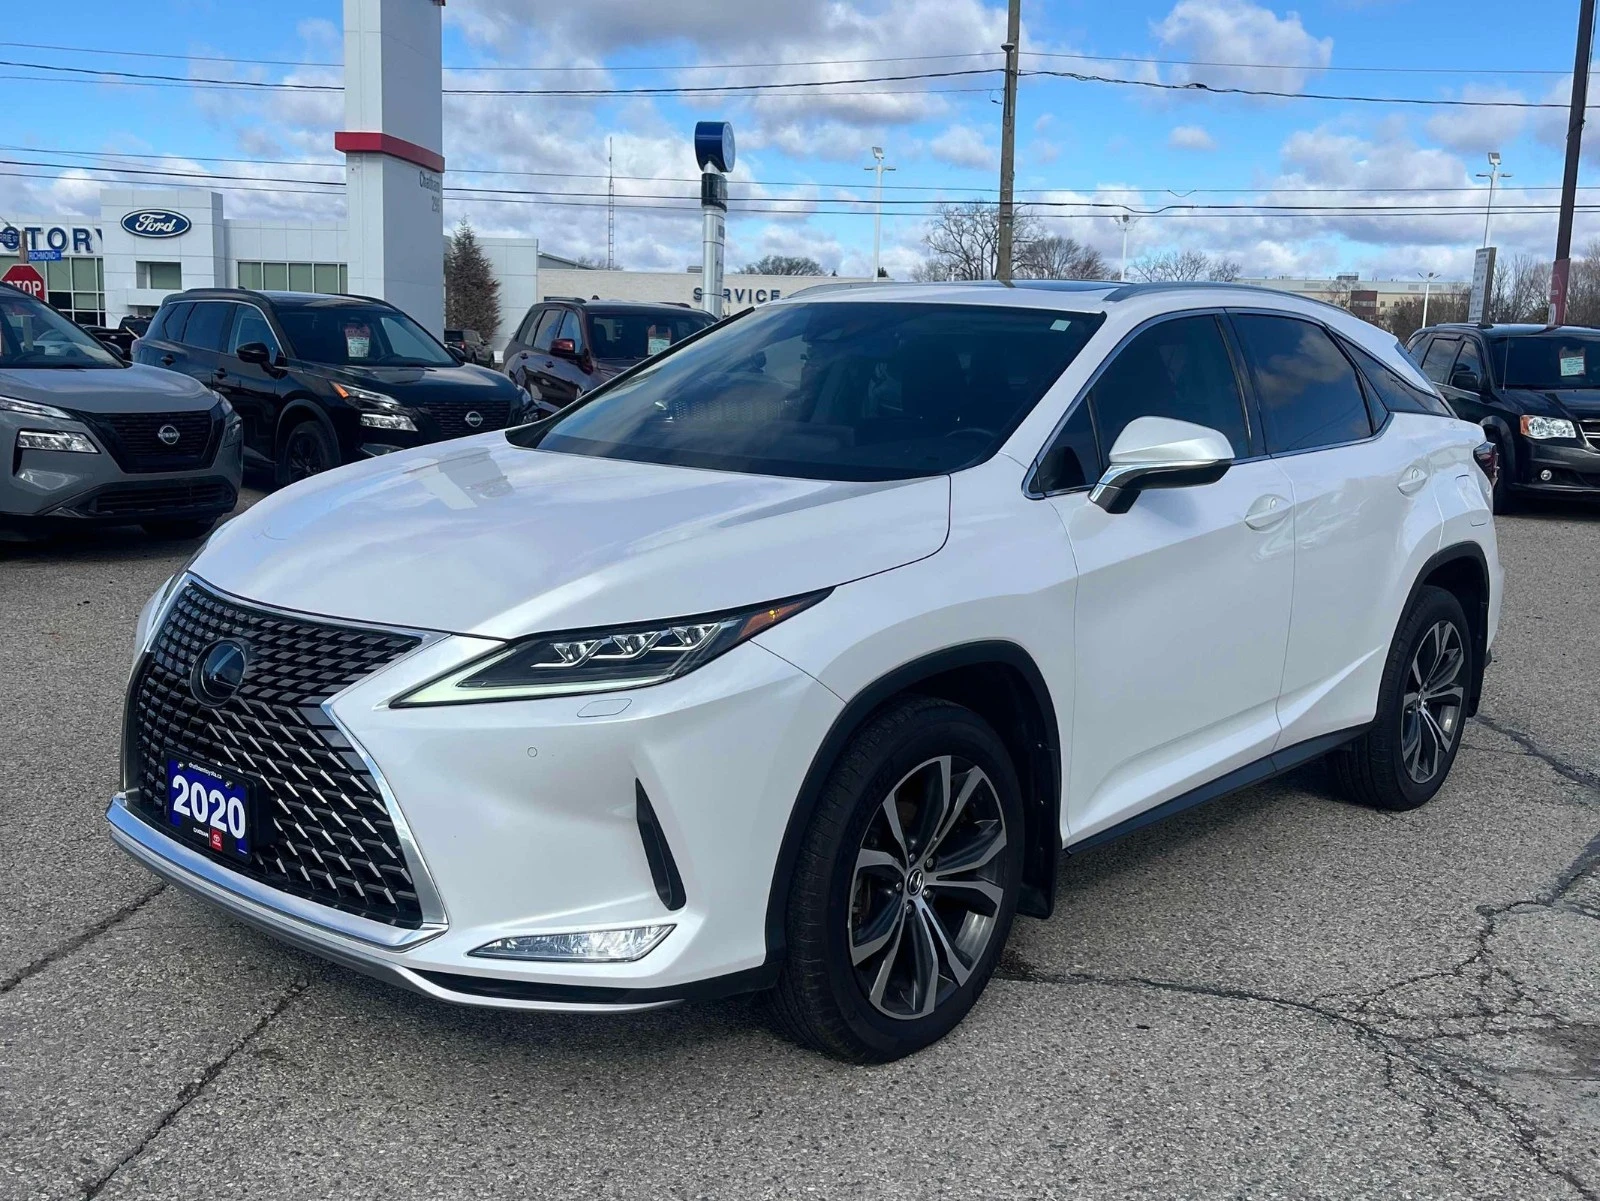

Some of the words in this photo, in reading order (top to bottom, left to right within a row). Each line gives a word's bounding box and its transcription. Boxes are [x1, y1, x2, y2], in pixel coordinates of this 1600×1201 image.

[135, 213, 177, 232] Ford
[693, 287, 781, 303] SRVICE
[172, 774, 246, 839] 2020
